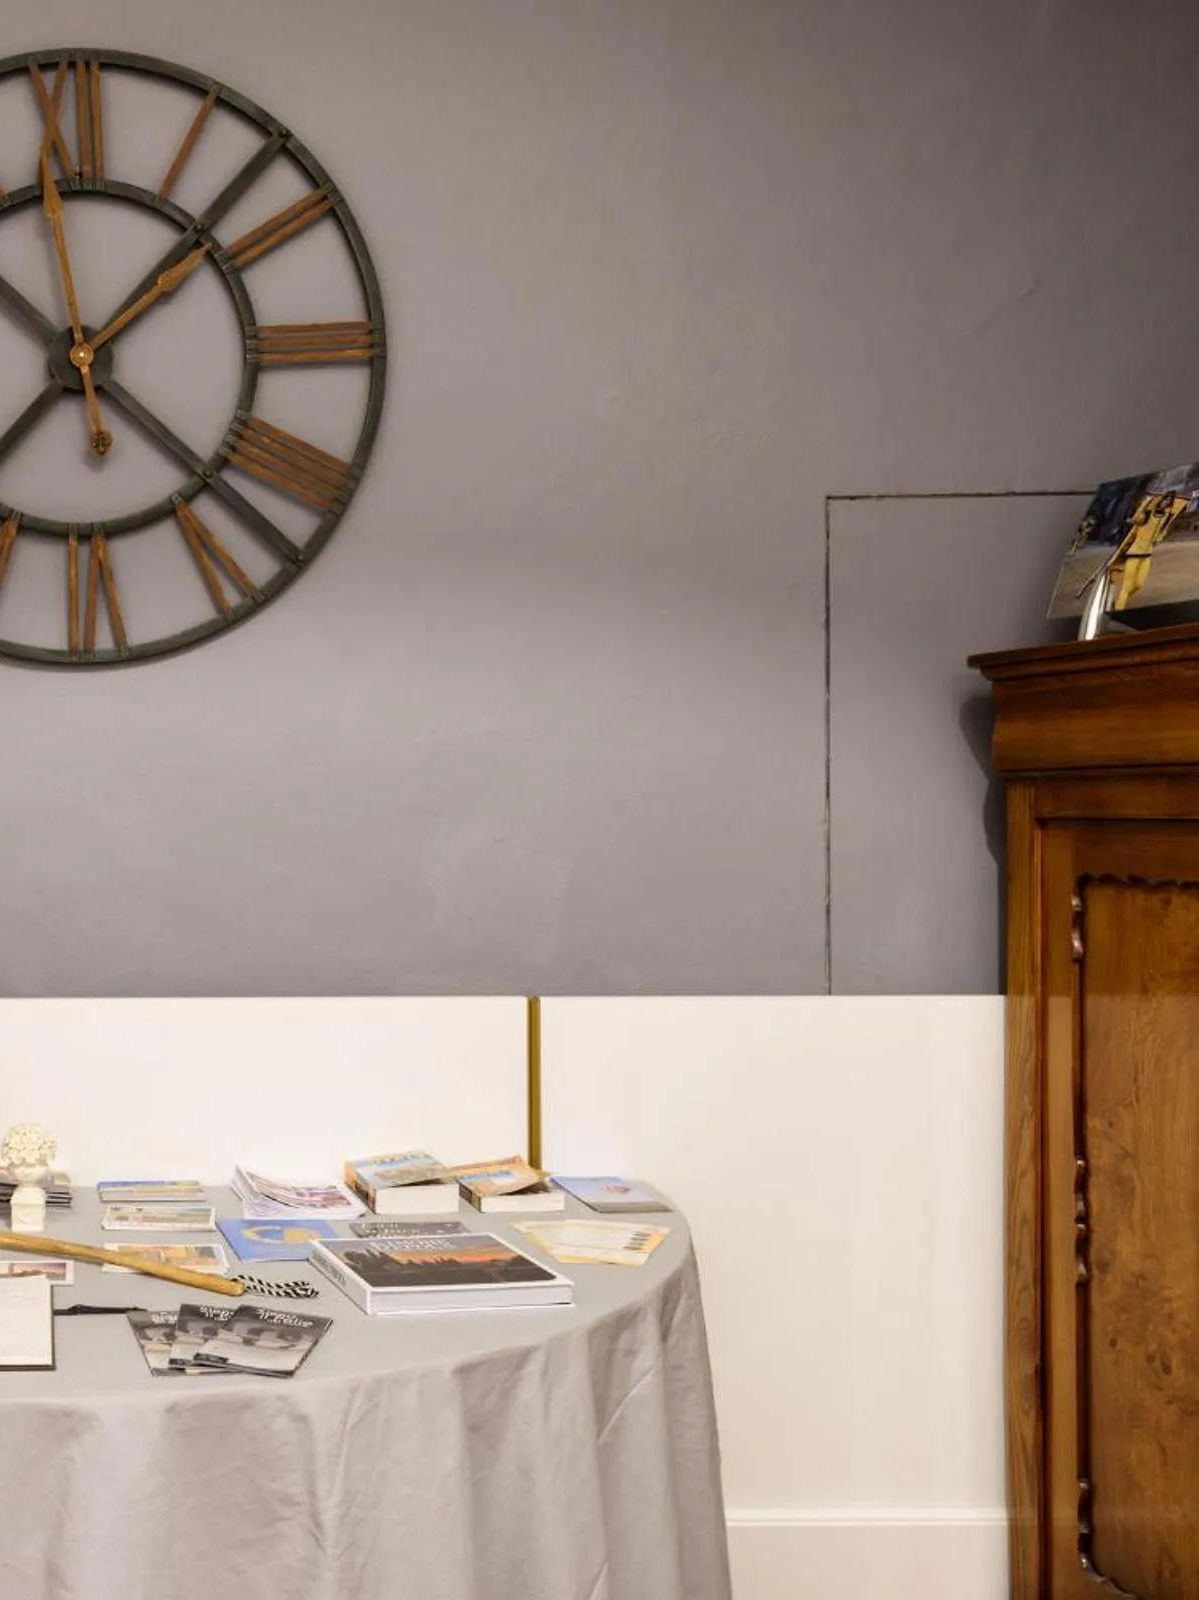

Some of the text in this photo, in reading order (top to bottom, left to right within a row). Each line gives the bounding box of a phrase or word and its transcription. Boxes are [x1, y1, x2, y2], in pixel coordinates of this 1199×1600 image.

[26, 57, 105, 186] XII
[156, 84, 221, 200] I
[223, 184, 339, 272] II
[250, 320, 380, 364] III
[67, 528, 130, 662] VI
[172, 497, 266, 620] V
